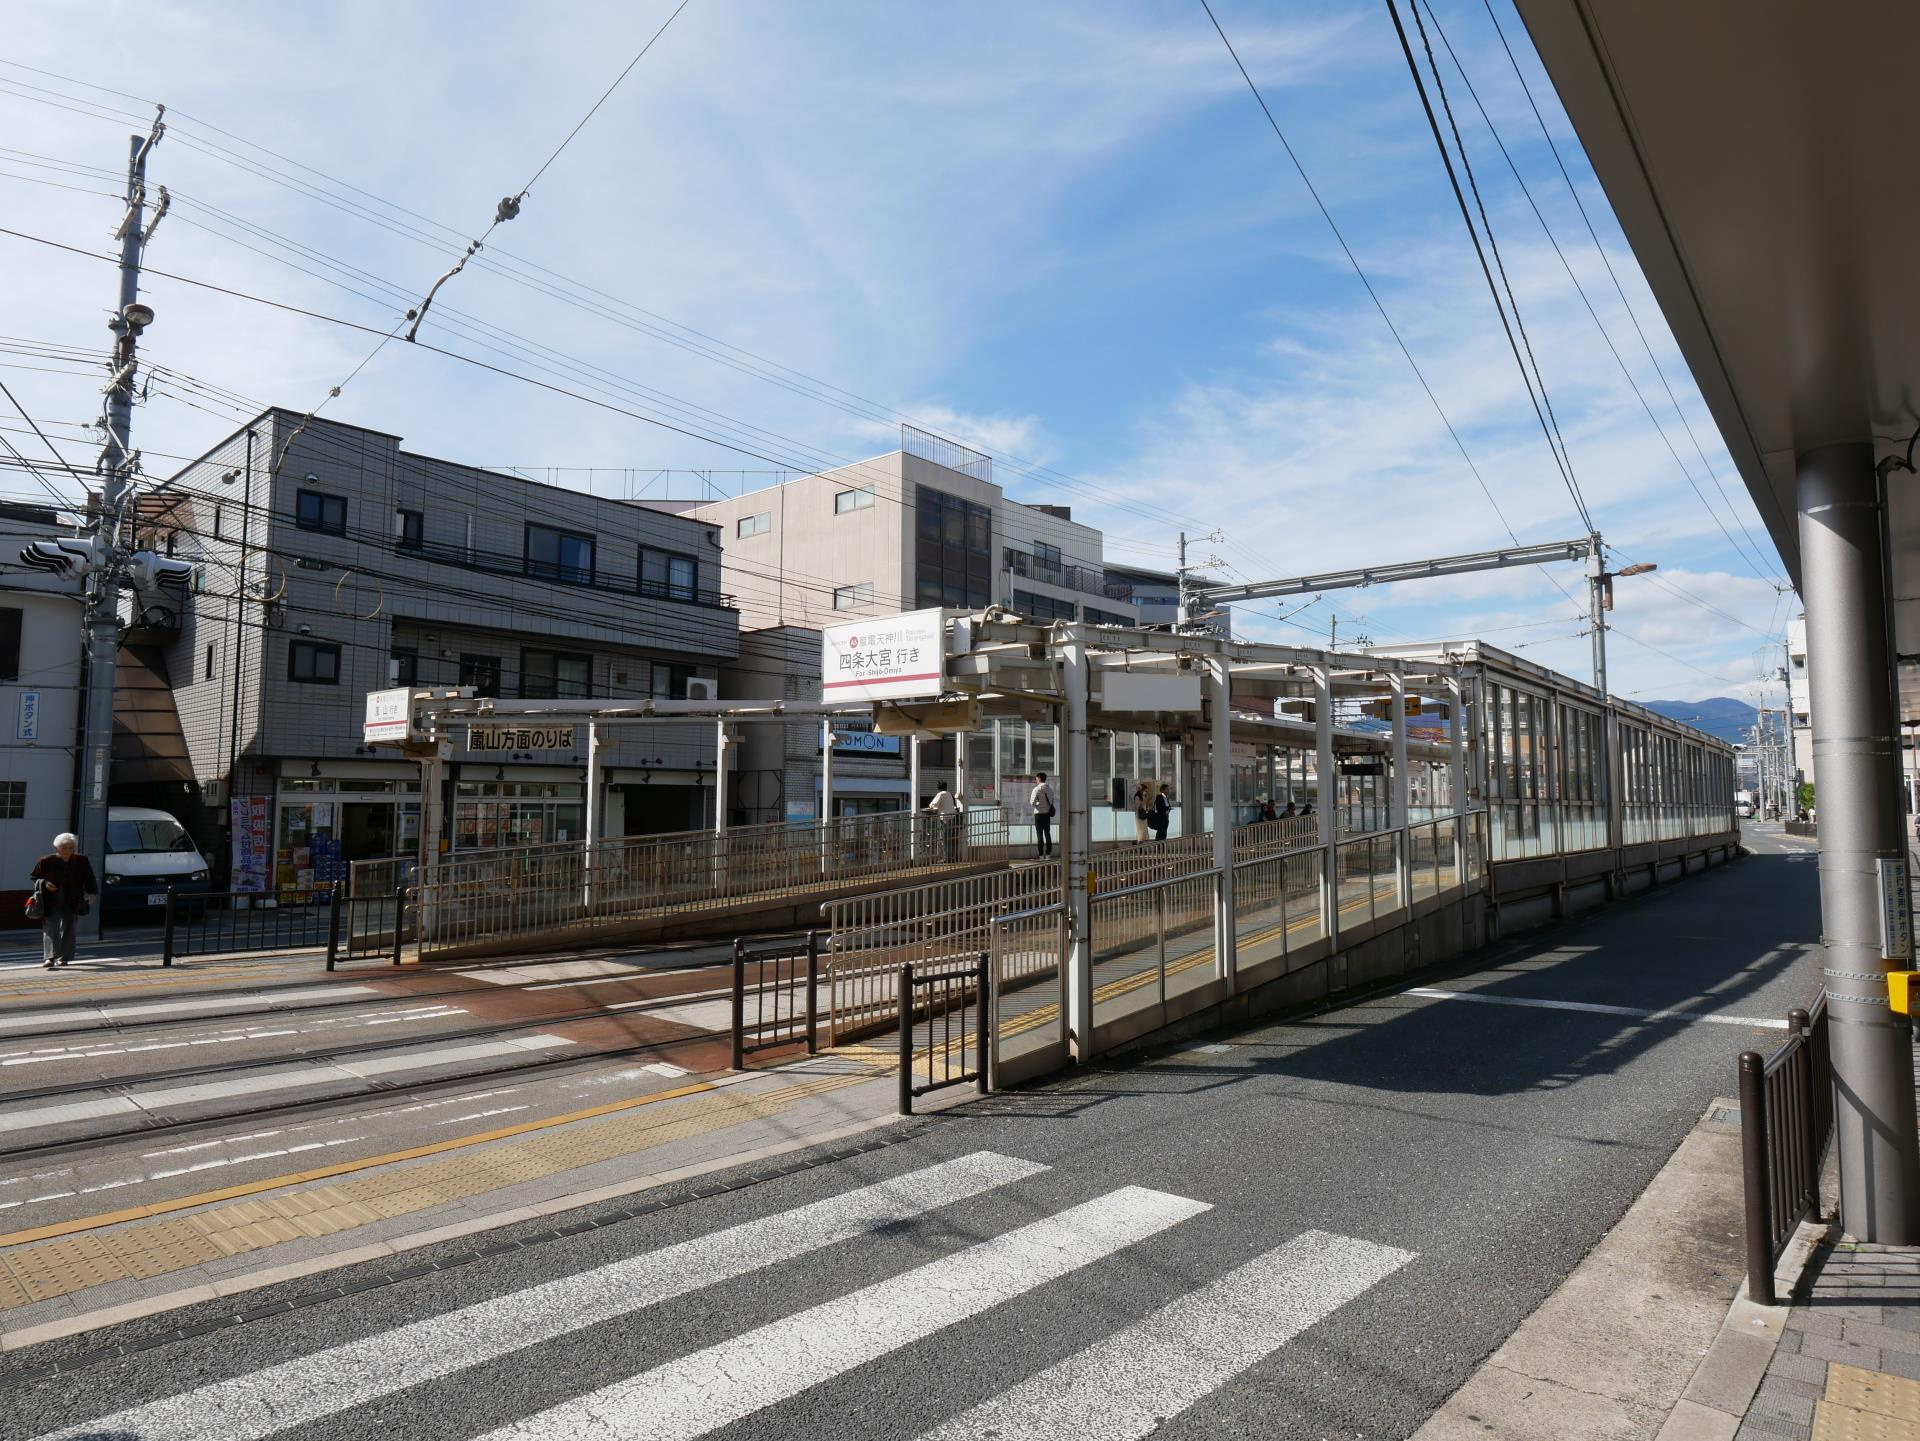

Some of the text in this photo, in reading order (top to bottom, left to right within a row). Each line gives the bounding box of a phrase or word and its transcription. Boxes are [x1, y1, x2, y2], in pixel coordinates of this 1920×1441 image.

[840, 648, 920, 670] 四条大宮 行き
[22, 694, 35, 737] 押ボタン式
[470, 729, 572, 750] 嵐山方面のりば
